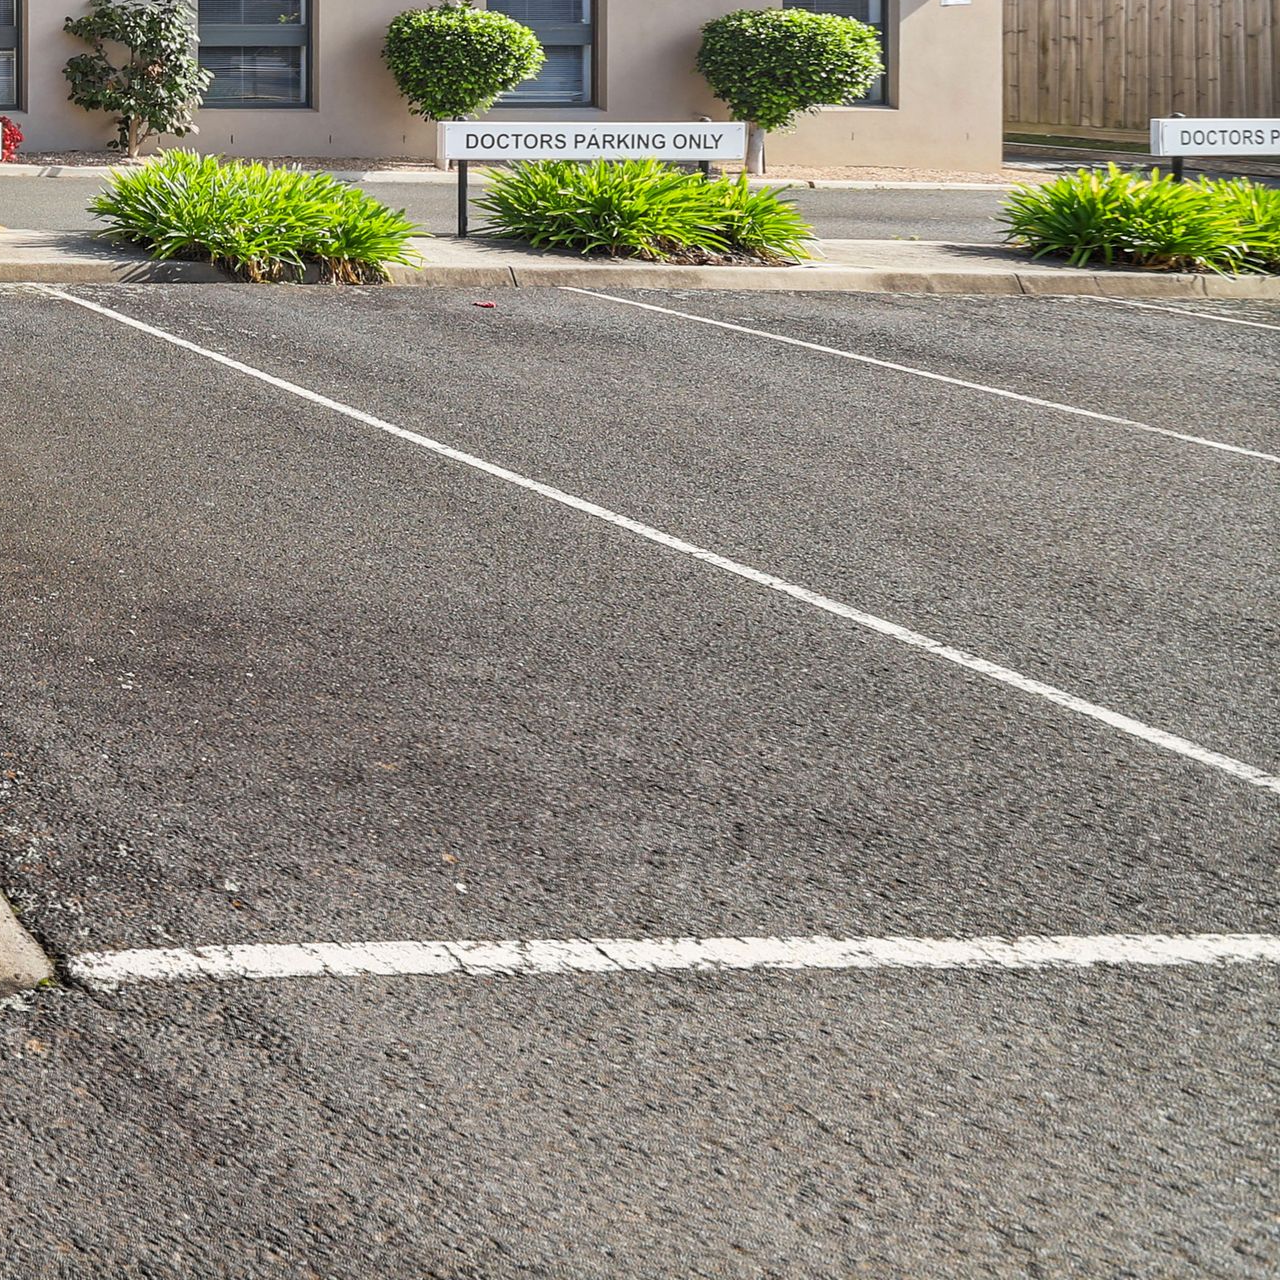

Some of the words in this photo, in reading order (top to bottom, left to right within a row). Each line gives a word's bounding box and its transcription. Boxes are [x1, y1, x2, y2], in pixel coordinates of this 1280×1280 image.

[465, 133, 567, 150] DOCTORS
[573, 133, 666, 150] PARKING
[672, 133, 724, 150] ONLY
[1180, 129, 1265, 146] DOCTORS
